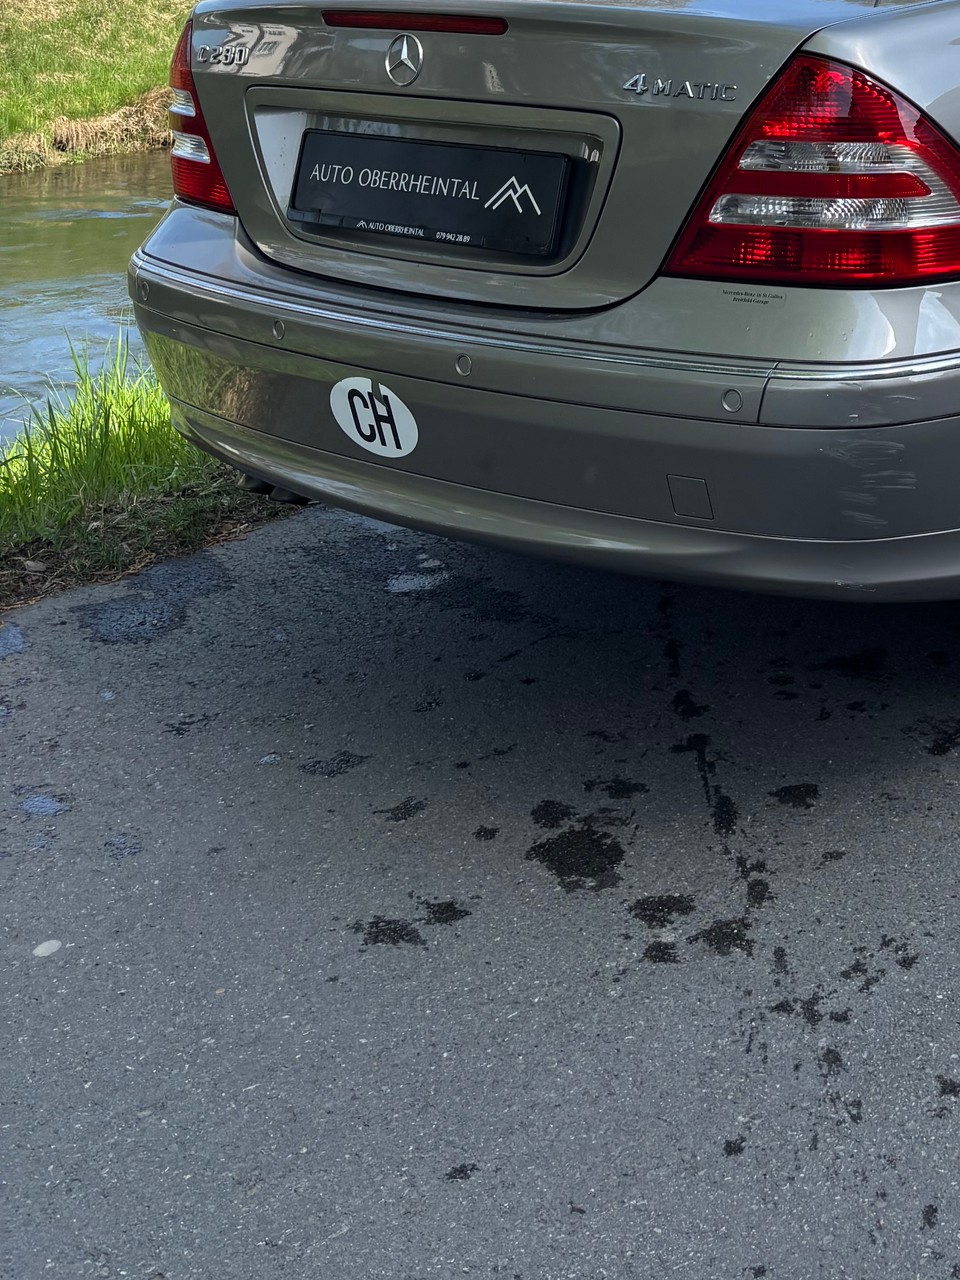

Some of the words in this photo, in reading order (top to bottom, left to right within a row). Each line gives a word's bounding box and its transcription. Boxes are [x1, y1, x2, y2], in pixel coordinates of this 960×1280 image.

[622, 73, 738, 101] 4MATIC
[310, 163, 354, 185] AUTO
[358, 168, 480, 200] OBERRHEINTAL
[368, 222, 384, 231] AUTO
[385, 223, 425, 236] OBERRHEINTAL
[347, 388, 402, 450] CH
